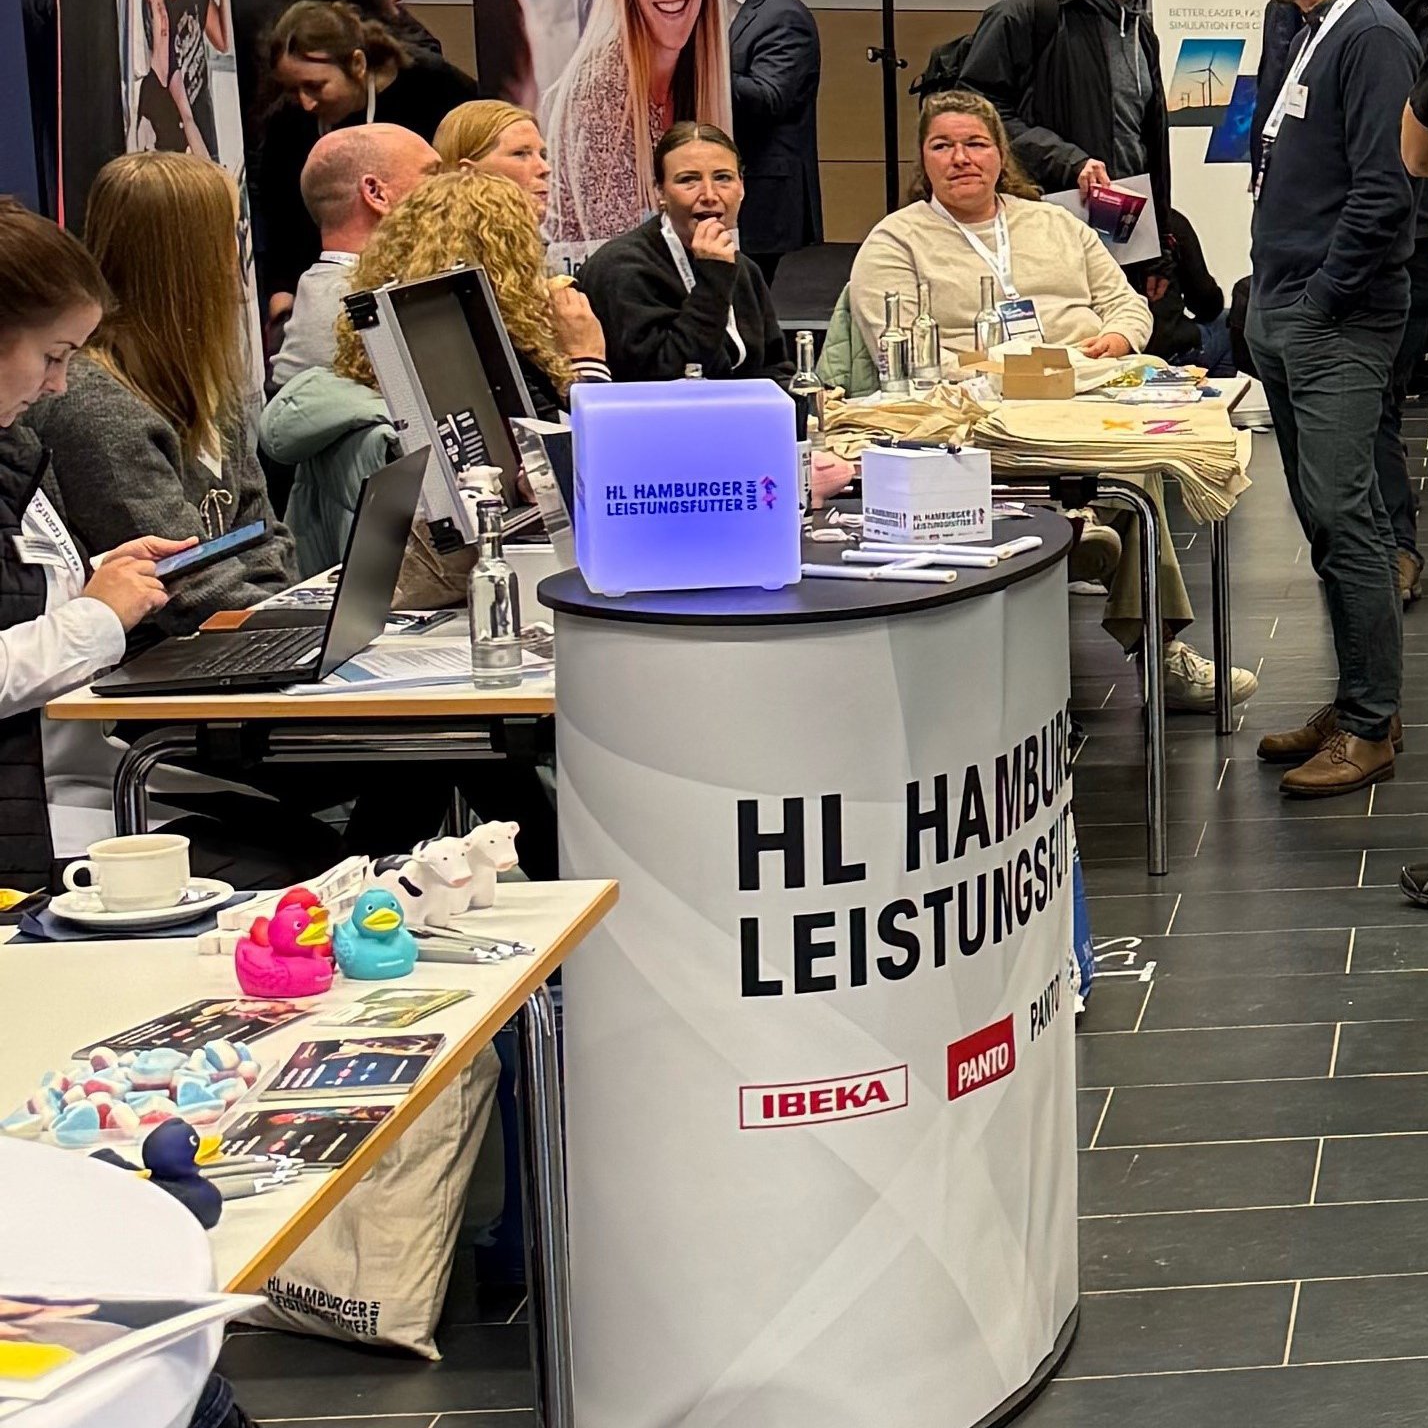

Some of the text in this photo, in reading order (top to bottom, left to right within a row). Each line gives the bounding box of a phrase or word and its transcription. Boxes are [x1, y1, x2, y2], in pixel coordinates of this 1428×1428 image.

[606, 481, 743, 501] HL HAMBURGER
[607, 498, 743, 516] LEISTUNGSFUTTER
[738, 794, 866, 890] HL
[957, 1040, 1008, 1089] PANTO
[762, 1079, 889, 1119] IBEKA
[268, 1276, 368, 1318] HL HAMBURGER
